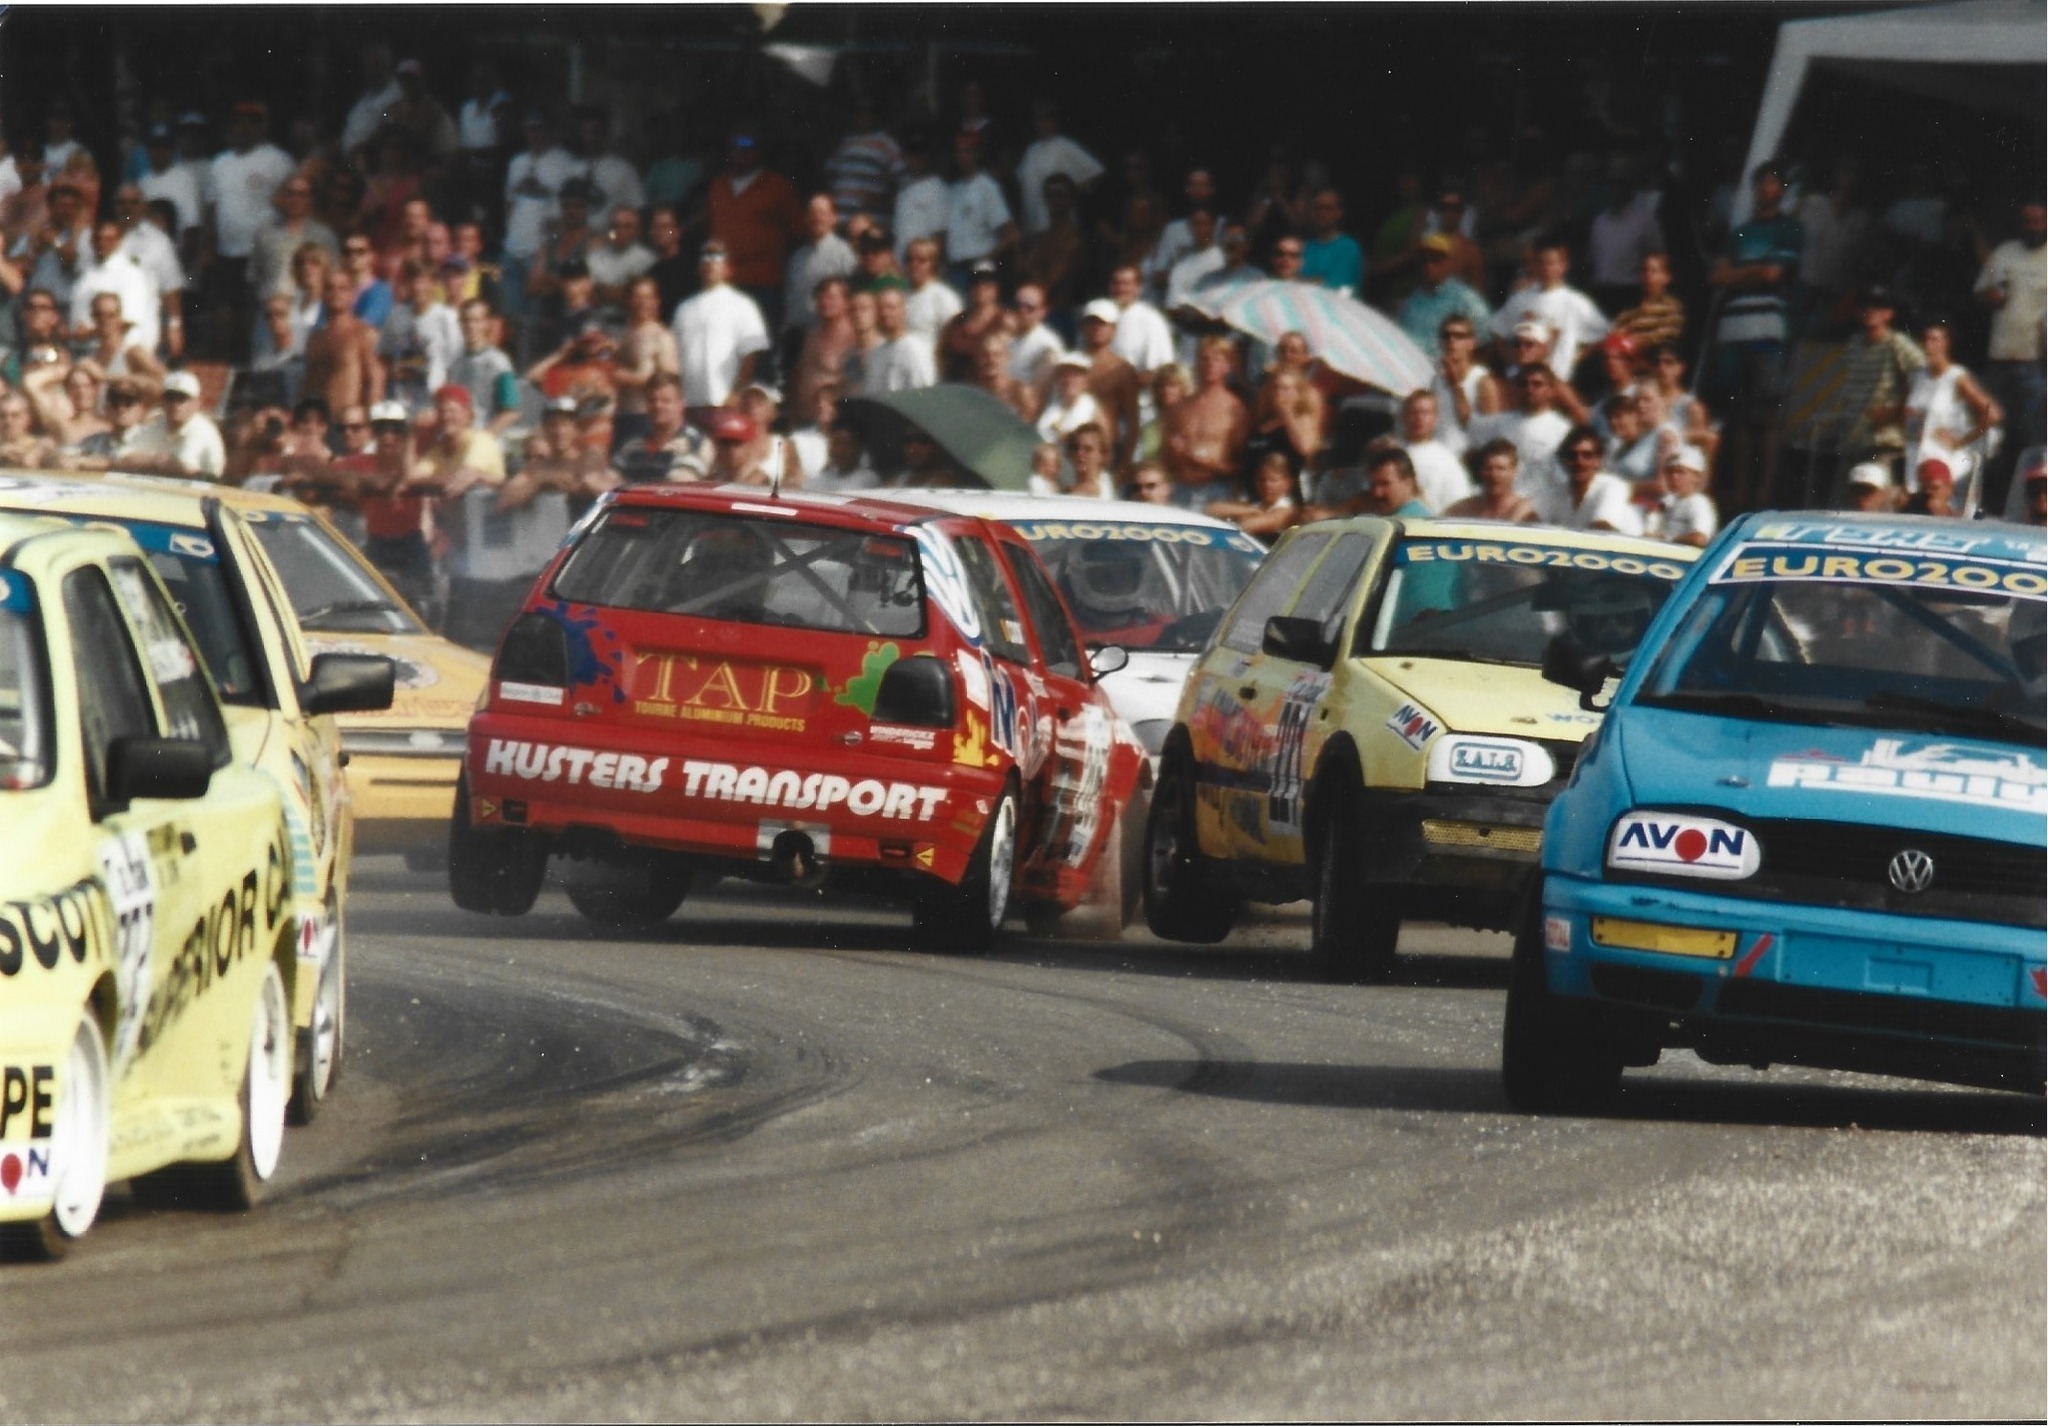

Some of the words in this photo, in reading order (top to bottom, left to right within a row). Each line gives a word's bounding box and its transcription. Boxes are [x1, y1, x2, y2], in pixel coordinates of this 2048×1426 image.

[1406, 545, 1686, 580] EURO2000
[1732, 554, 2047, 596] EURO200
[636, 653, 812, 713] TAP
[746, 713, 806, 733] PRODUCTS
[1392, 703, 1438, 742] AVON
[486, 739, 669, 794] KUSTERS
[682, 760, 948, 822] TRANSPORT
[1620, 822, 1744, 862] AVON
